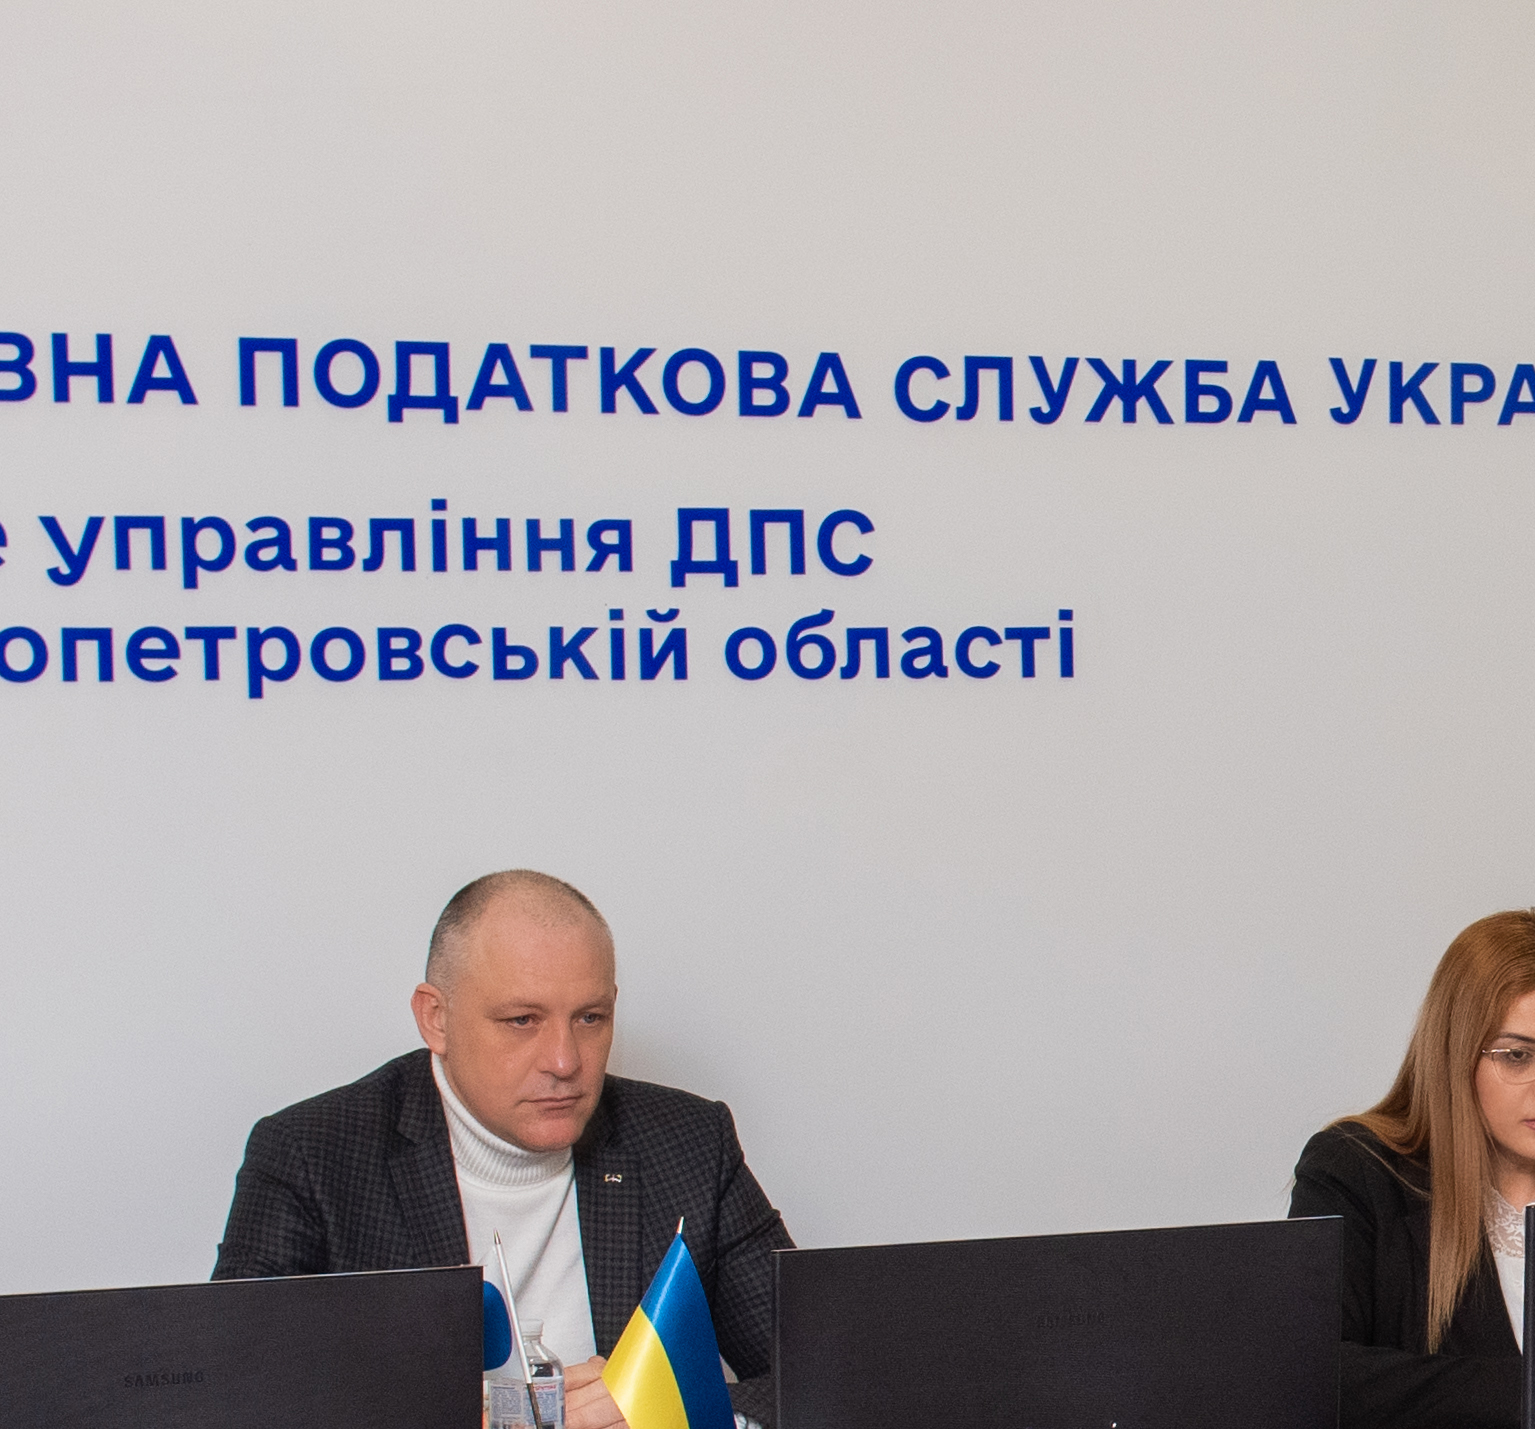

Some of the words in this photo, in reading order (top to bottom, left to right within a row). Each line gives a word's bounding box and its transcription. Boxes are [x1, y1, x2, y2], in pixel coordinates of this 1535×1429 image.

[238, 336, 862, 425] ПОДАТКОВА
[893, 353, 1297, 426] СЛУЖБА
[38, 499, 633, 590] управління
[670, 507, 876, 588] ДПС
[724, 608, 1076, 680] області
